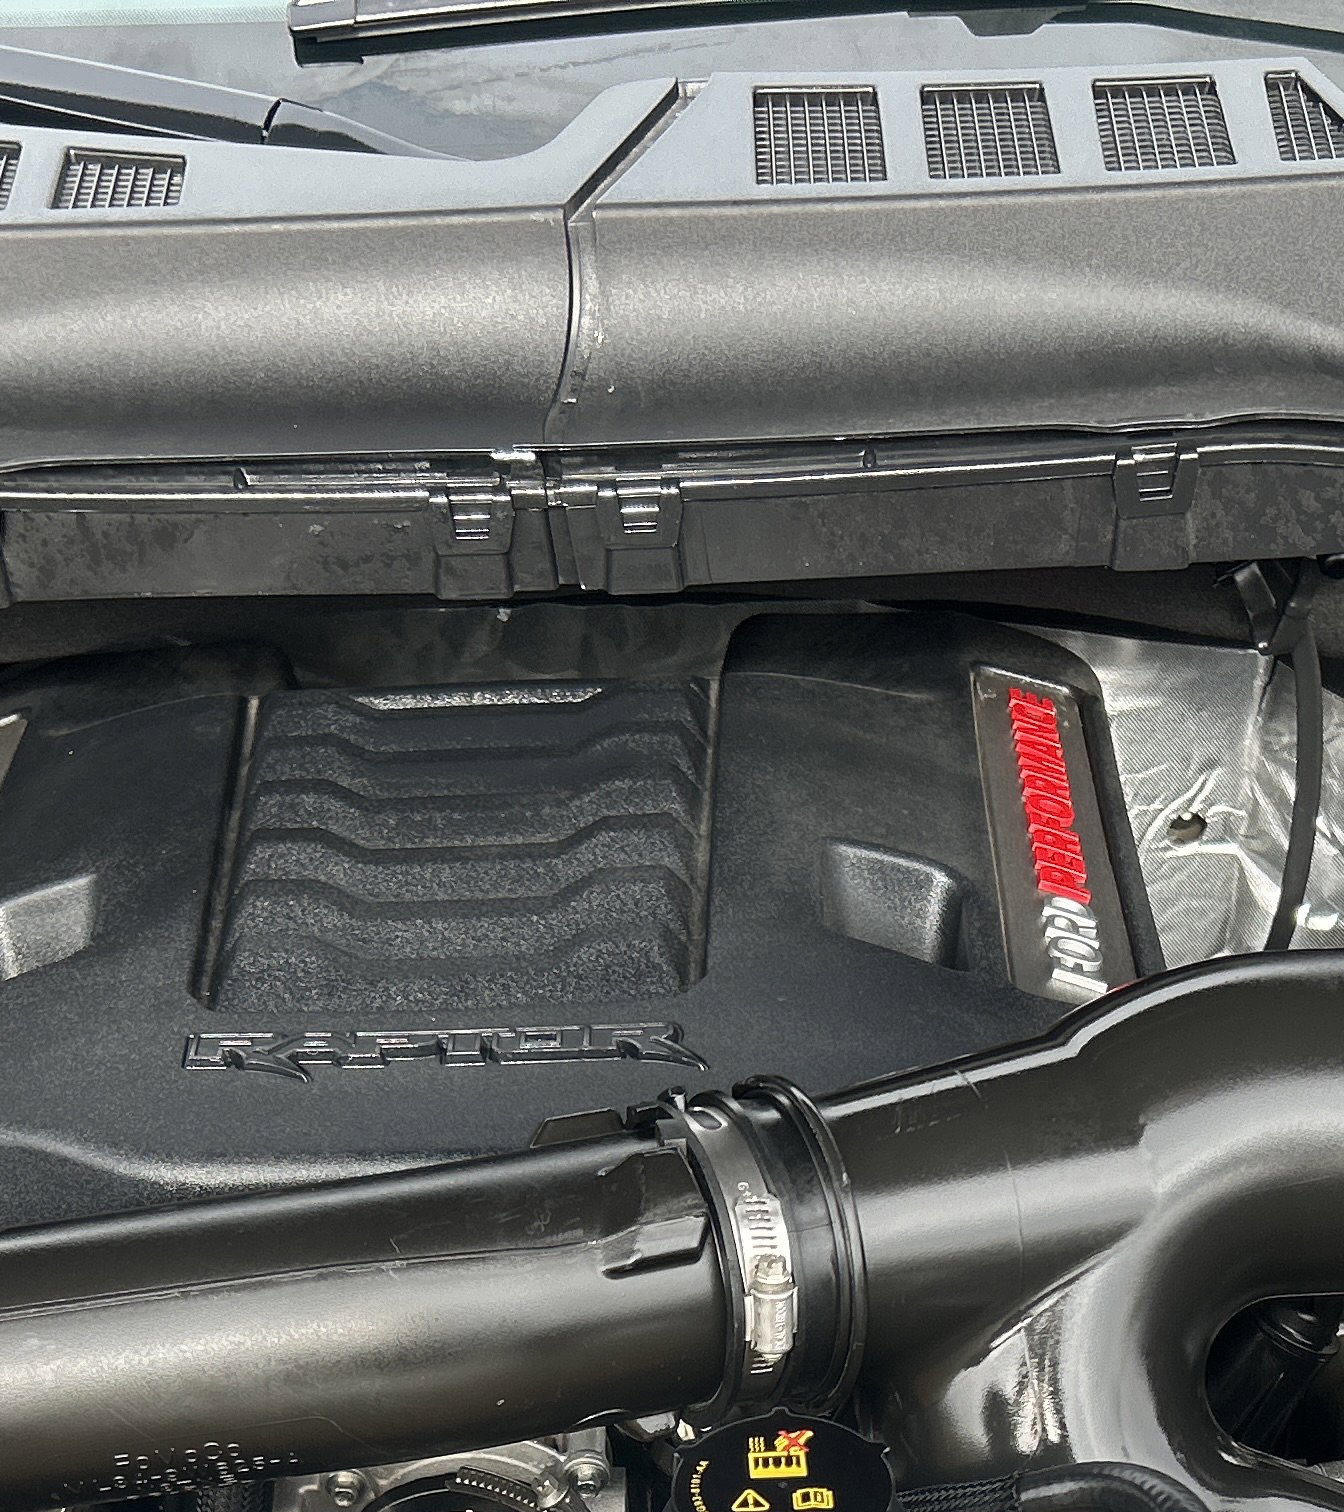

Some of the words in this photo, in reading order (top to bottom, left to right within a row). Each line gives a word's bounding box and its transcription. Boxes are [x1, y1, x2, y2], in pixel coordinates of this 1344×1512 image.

[1007, 687, 1091, 904] PERFORMANCE
[1041, 895, 1109, 994] FORD
[182, 1022, 710, 1084] RAPTOR
